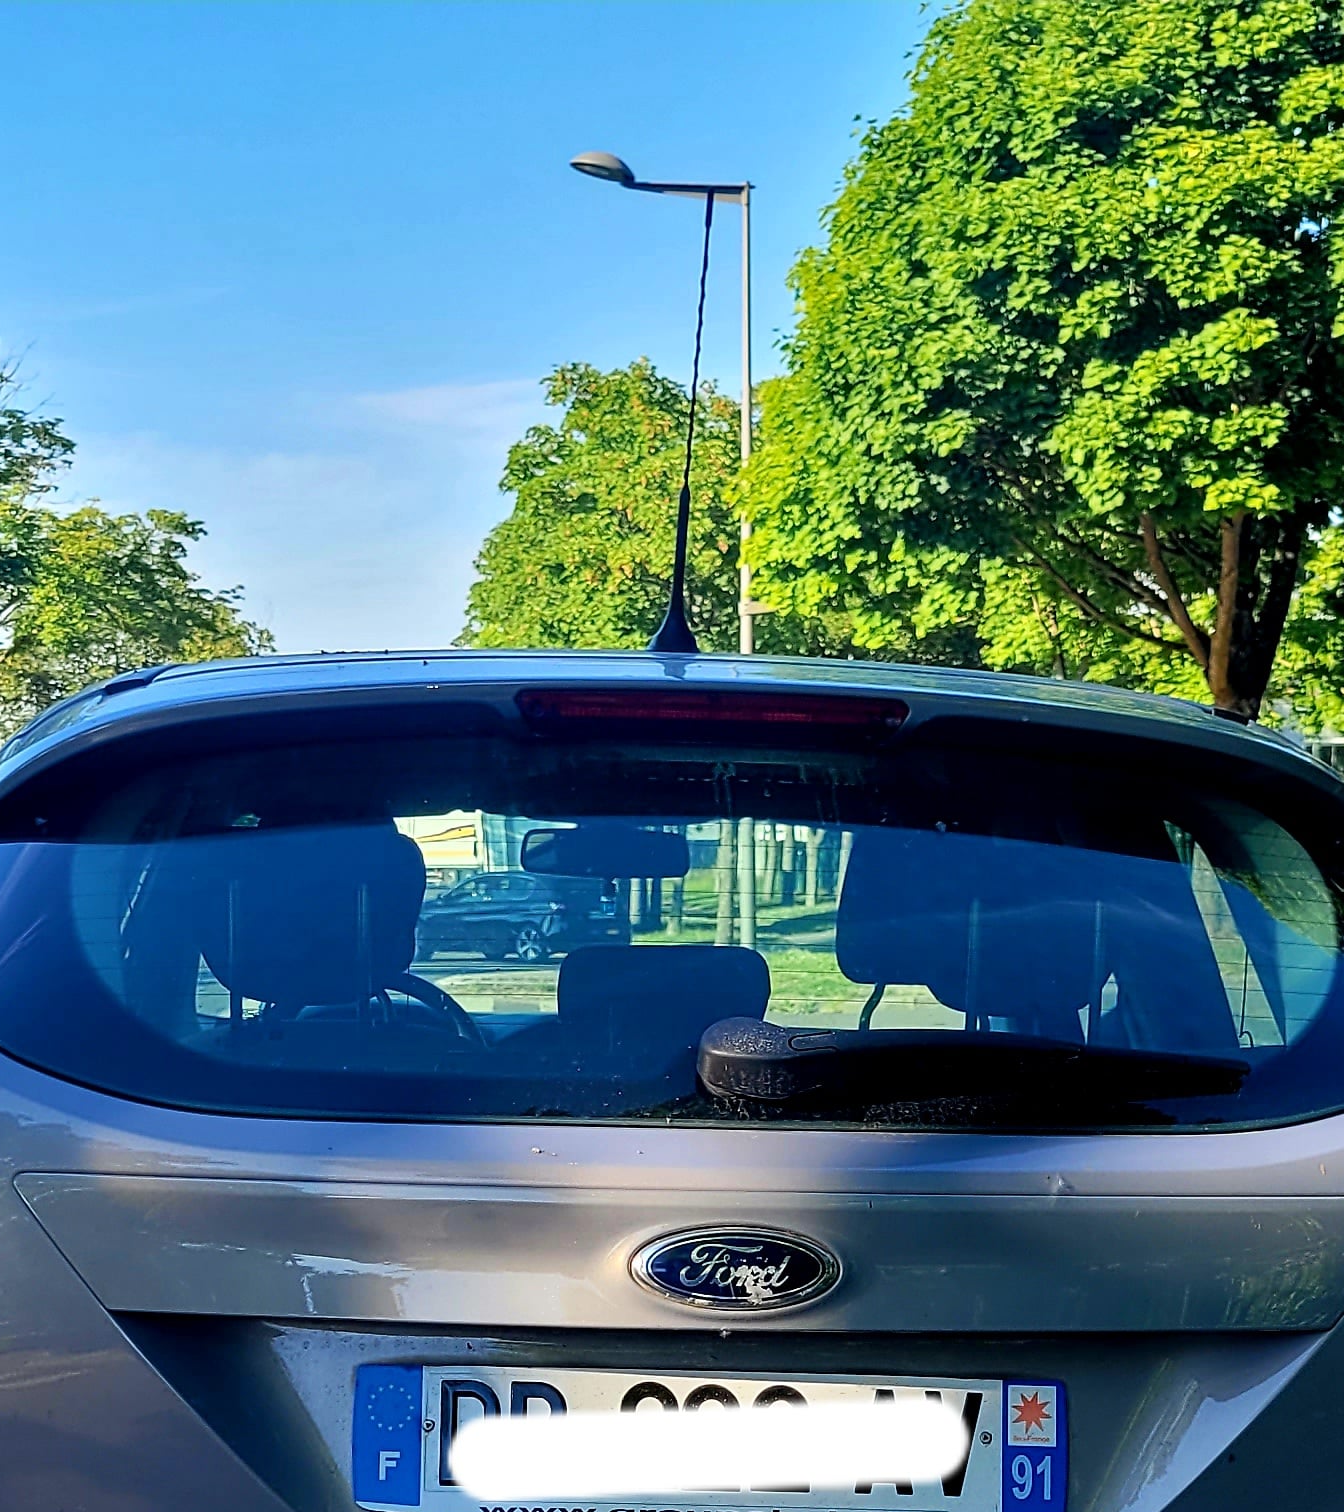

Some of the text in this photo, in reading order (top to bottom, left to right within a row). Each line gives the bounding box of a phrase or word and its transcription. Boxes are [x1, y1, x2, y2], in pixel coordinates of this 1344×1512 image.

[680, 1243, 791, 1288] Ford
[378, 1451, 401, 1481] F
[1011, 1454, 1052, 1501] 91
